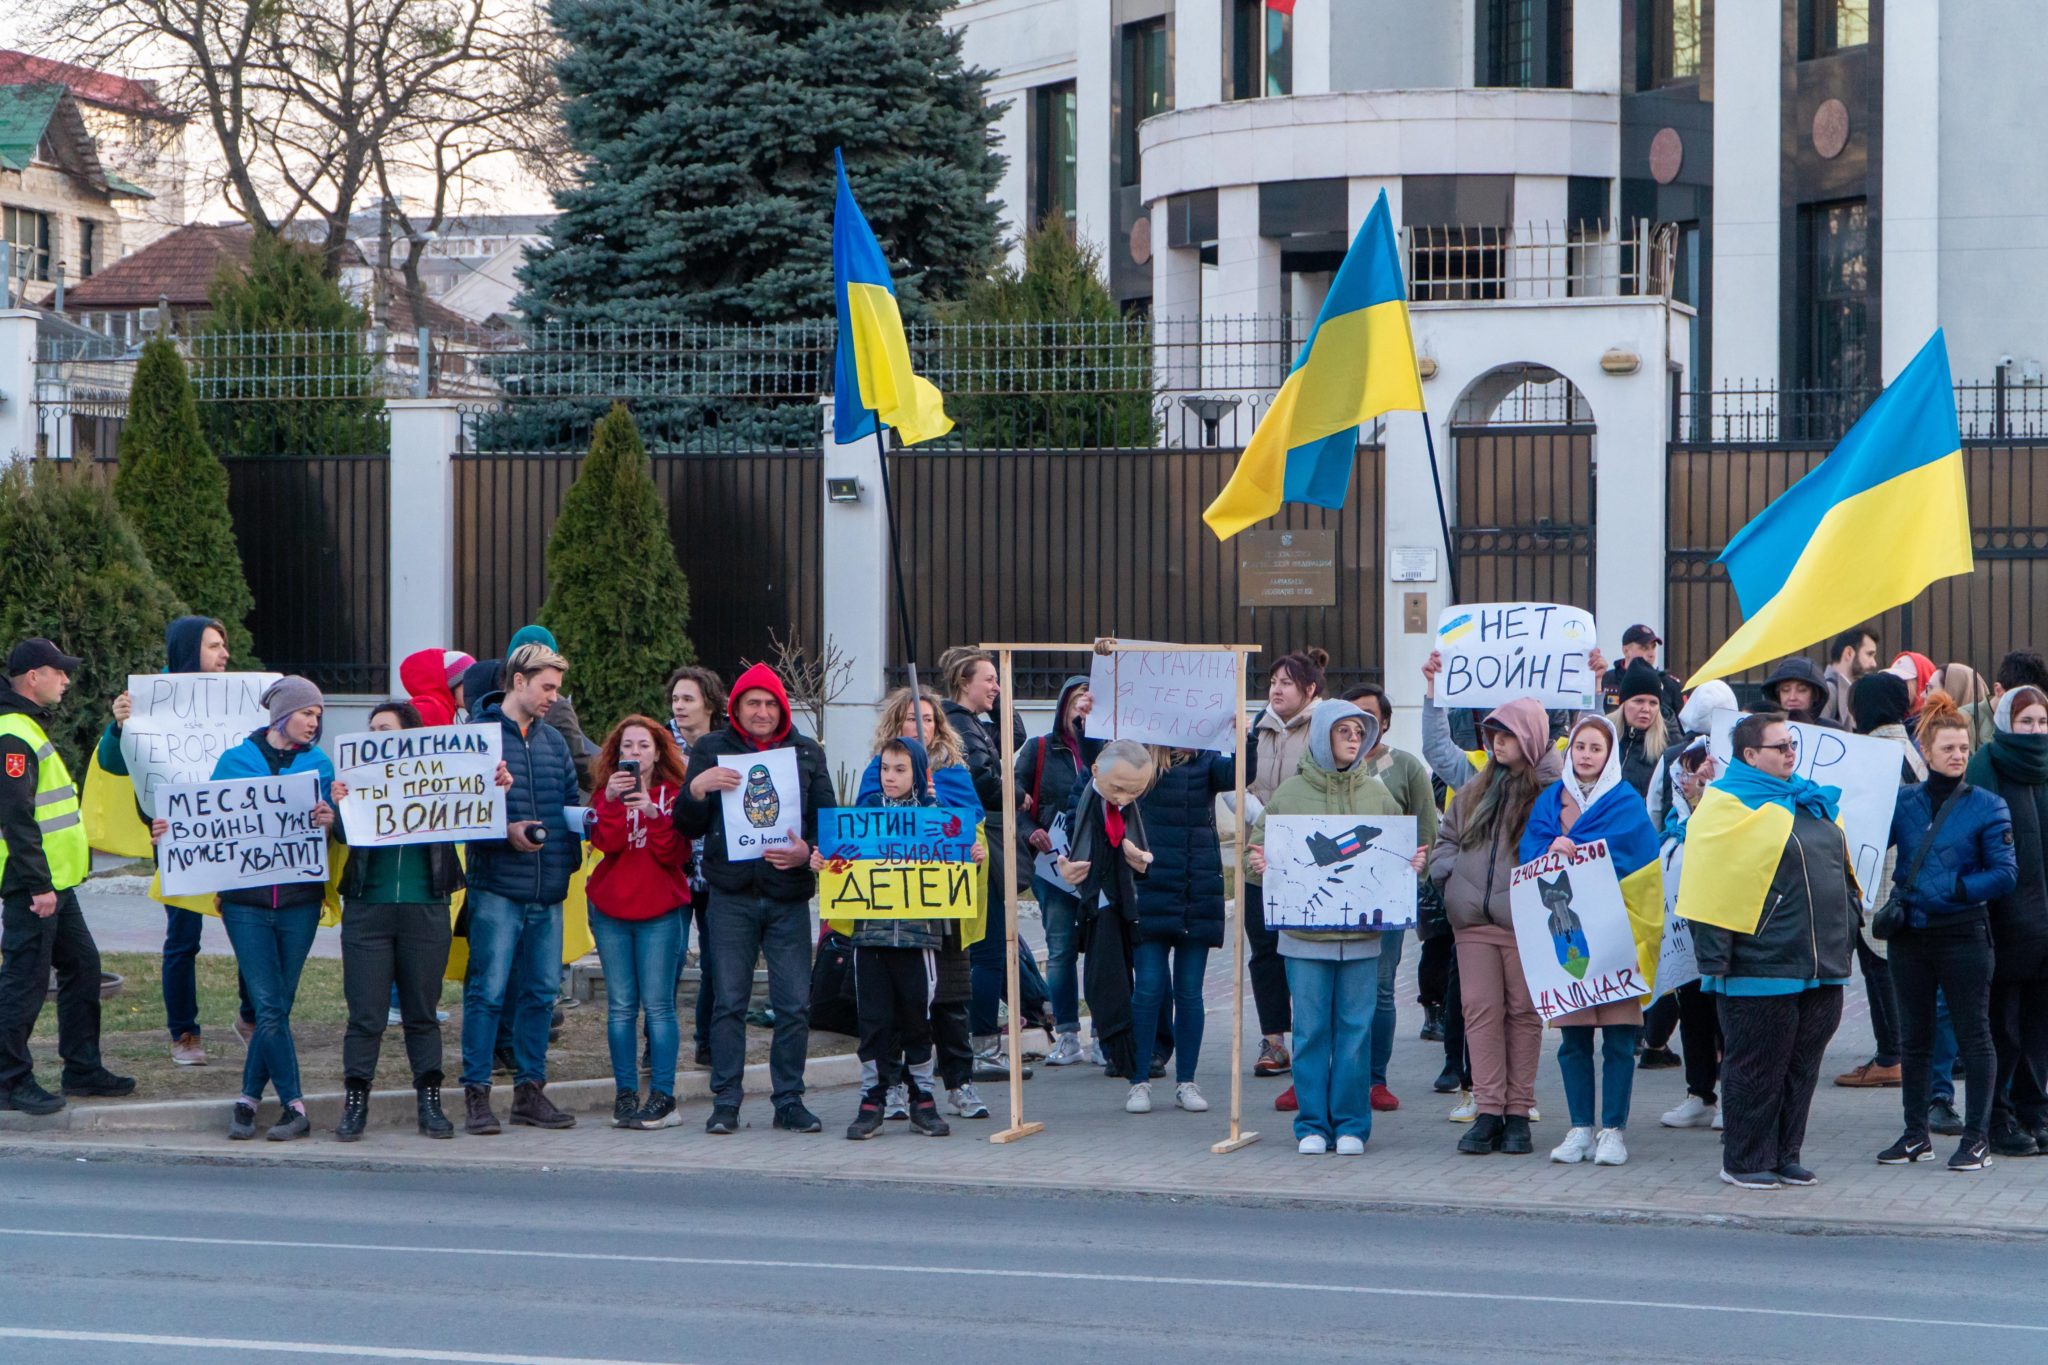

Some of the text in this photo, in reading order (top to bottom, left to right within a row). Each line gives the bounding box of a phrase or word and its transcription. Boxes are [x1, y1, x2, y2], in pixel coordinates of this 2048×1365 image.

[1481, 606, 1557, 642] НЕТ
[1447, 646, 1583, 696] ВОЙНЕ
[150, 678, 262, 719] PUTIN
[1117, 682, 1223, 710] Я ТЕБЯ
[340, 734, 490, 769] ПОСИГНАЛЬ
[386, 760, 444, 779] ЕСЛИ
[168, 784, 286, 817] МЕСЯЦ
[356, 774, 486, 800] ТЫ ПРОТИВ
[172, 813, 264, 841] ВОЙНЫ
[376, 796, 493, 837] ВОЙНЫ
[837, 811, 916, 839] ПУТИН
[739, 834, 756, 846] Go
[875, 841, 973, 866] УБИВАЕТ
[168, 841, 239, 874] МОЖЕТ
[831, 865, 972, 910] ДЕТЕЙ
[1536, 968, 1647, 1018] #NOWAR
